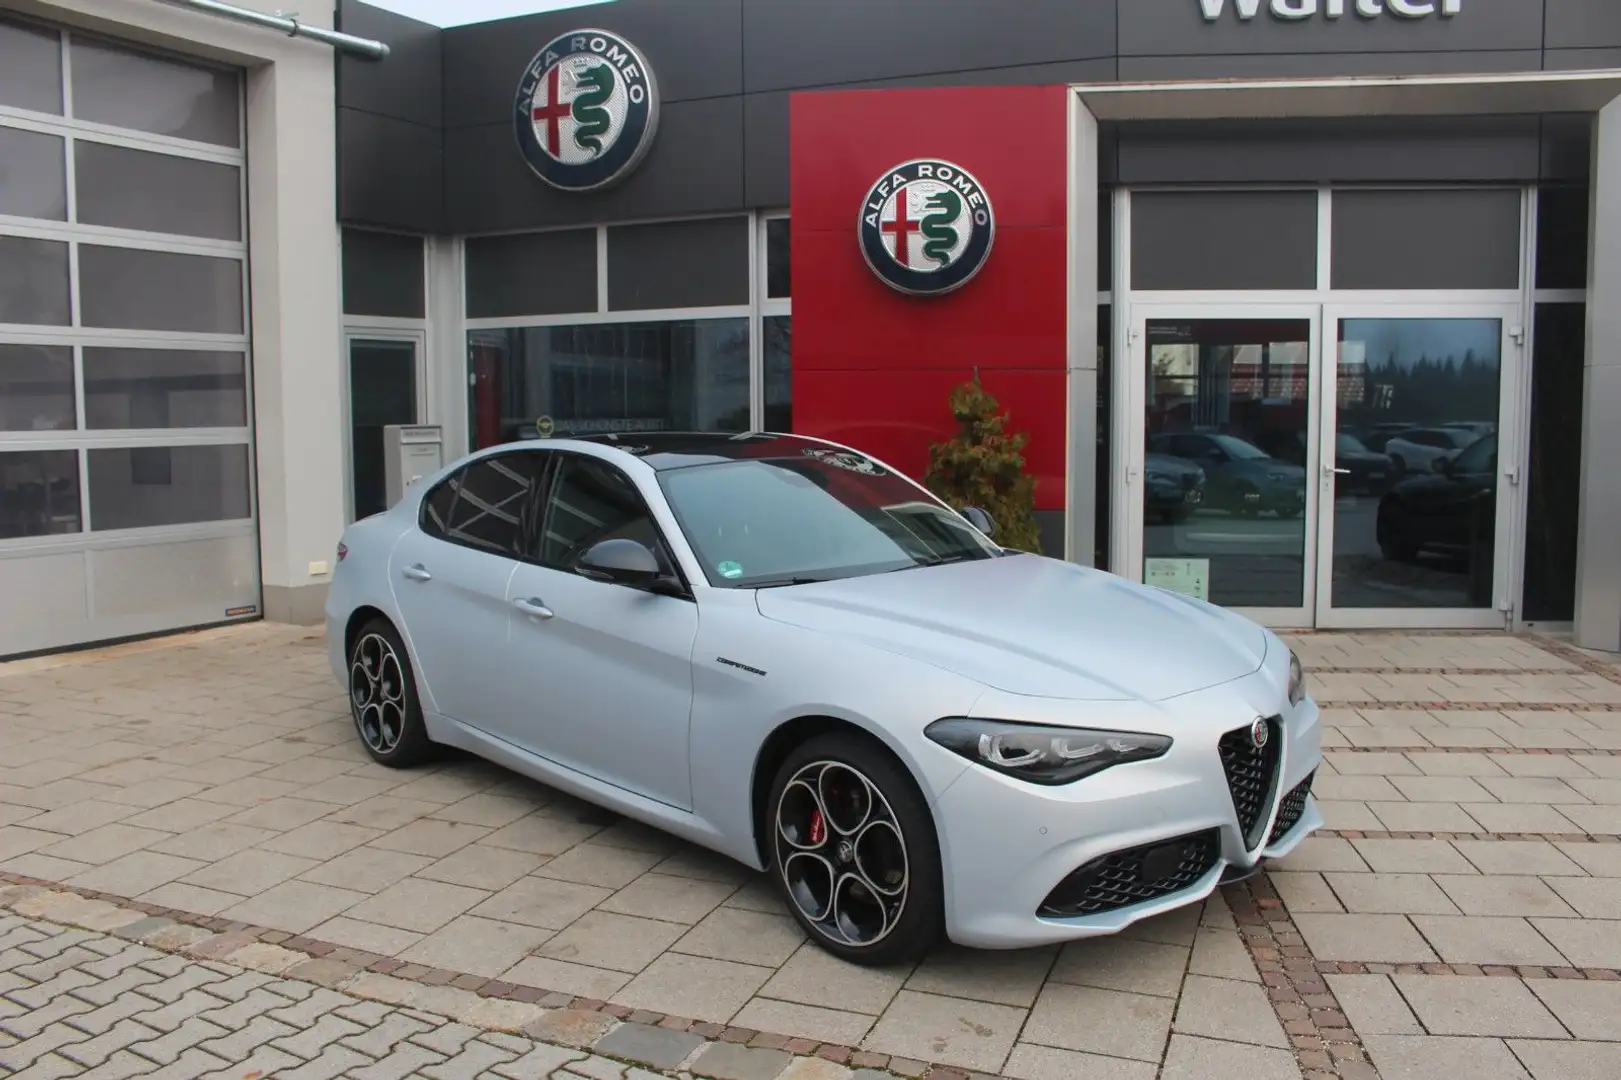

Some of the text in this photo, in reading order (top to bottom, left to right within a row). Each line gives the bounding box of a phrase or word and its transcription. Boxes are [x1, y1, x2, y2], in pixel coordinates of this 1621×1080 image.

[518, 37, 644, 116] ALFA ROMEO
[865, 164, 988, 228] ALFA ROMEO
